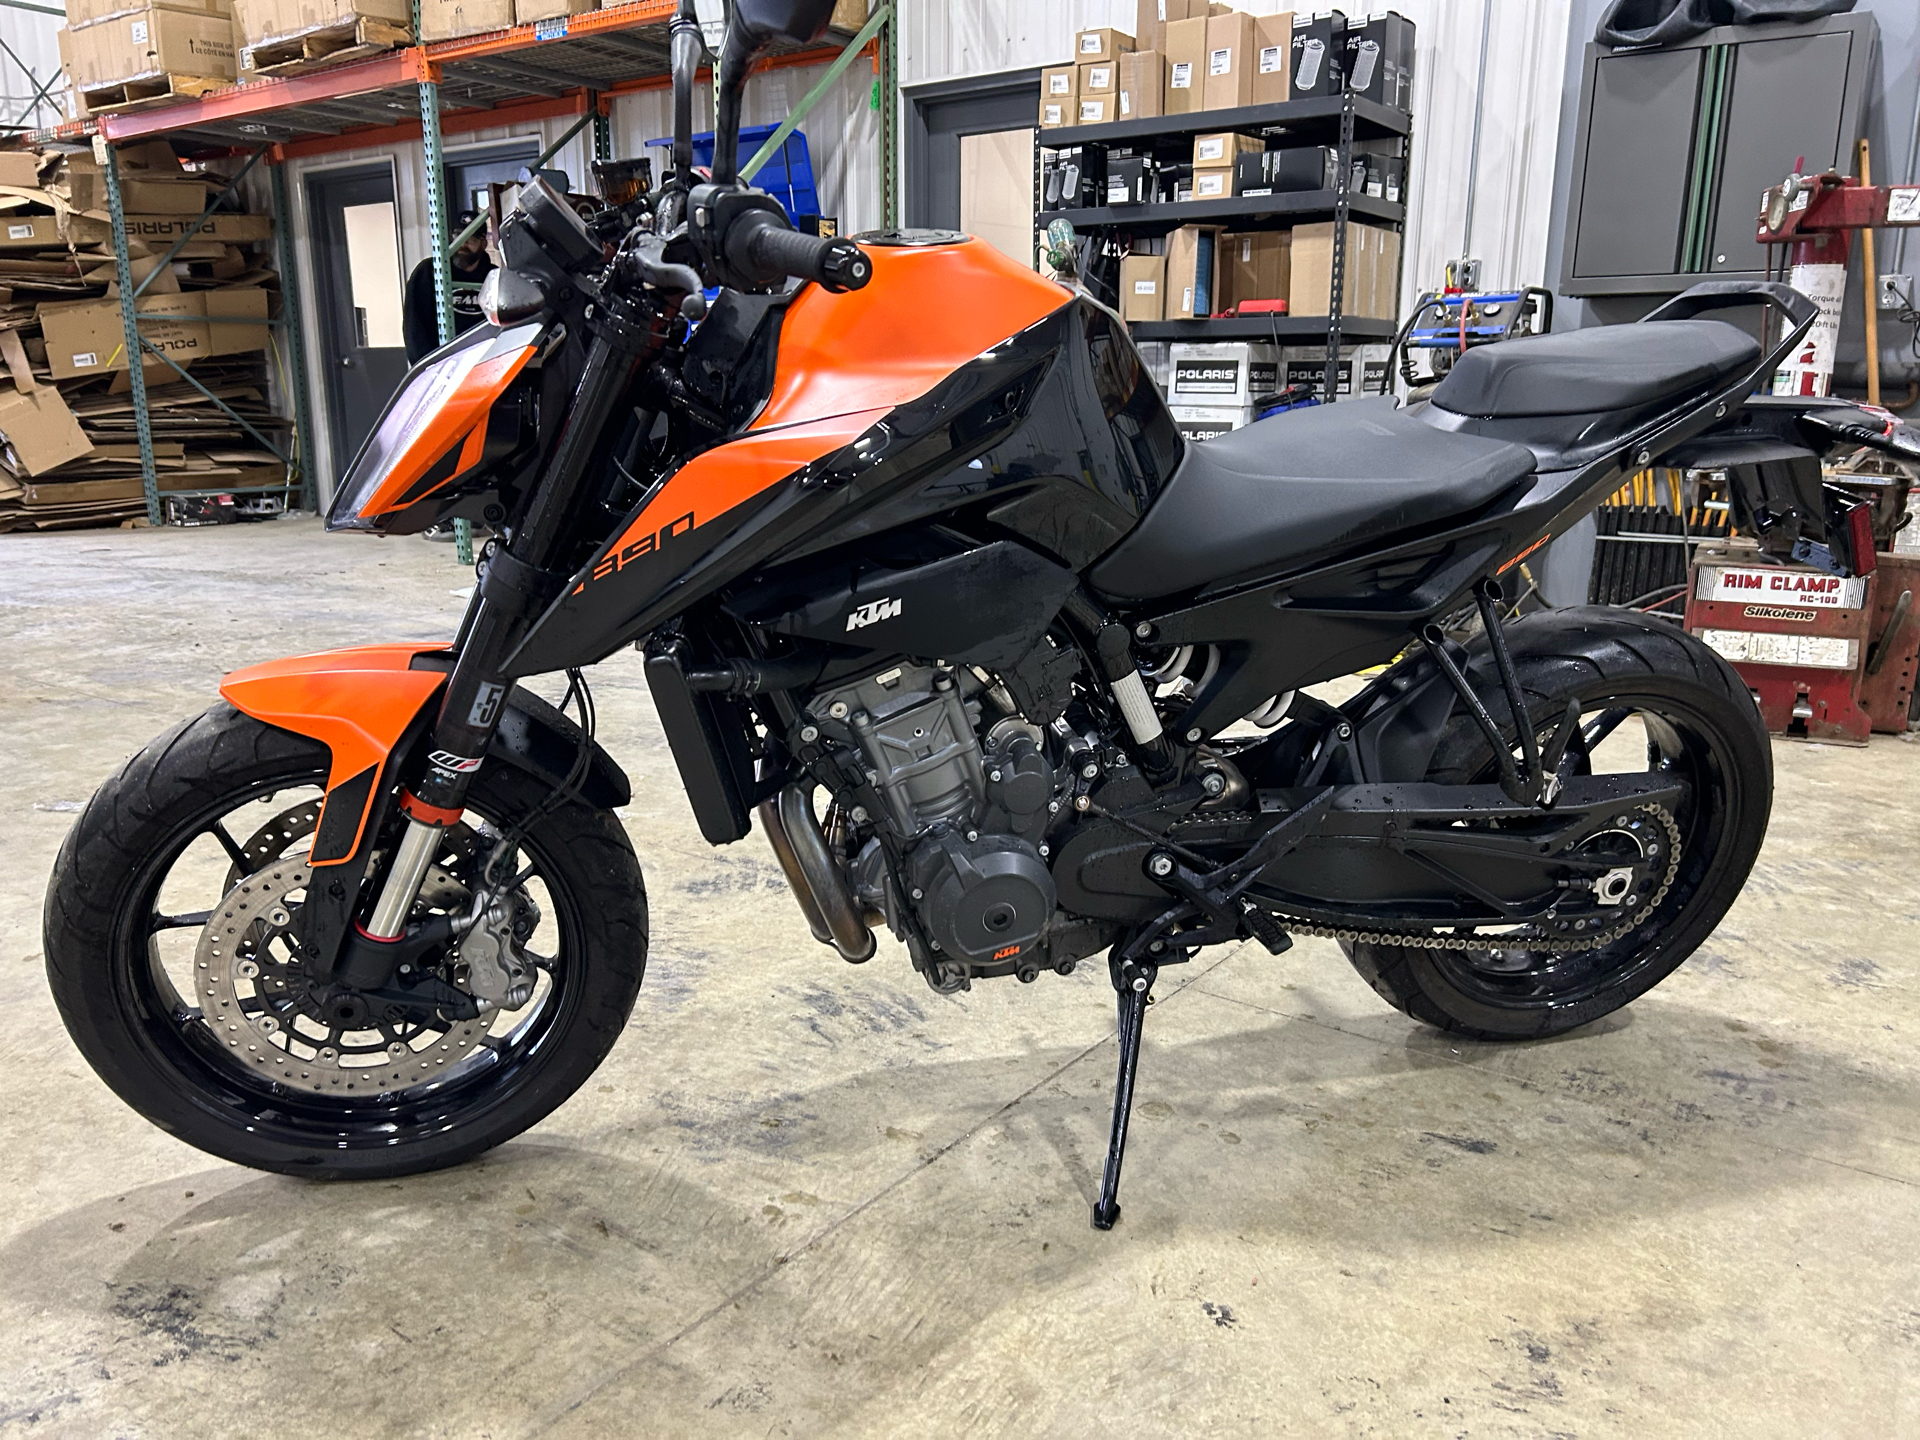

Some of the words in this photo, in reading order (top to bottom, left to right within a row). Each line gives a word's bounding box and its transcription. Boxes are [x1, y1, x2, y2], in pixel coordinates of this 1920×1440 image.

[1292, 38, 1318, 49] FILTER
[1293, 34, 1307, 43] AIR
[1347, 35, 1361, 44] AIR
[1346, 39, 1373, 50] FILTER
[1808, 294, 1835, 303] Torque
[1177, 369, 1235, 380] POLARIS
[1250, 370, 1275, 380] POLARIS
[1288, 370, 1348, 380] POLAS
[1723, 573, 1762, 590] RIM
[1770, 575, 1841, 593] CLAMP
[1799, 594, 1838, 604] RC-100
[846, 597, 902, 632] KTM
[1744, 606, 1816, 621] Silkolene
[431, 766, 458, 780] APEX
[993, 945, 1020, 961] KTM
